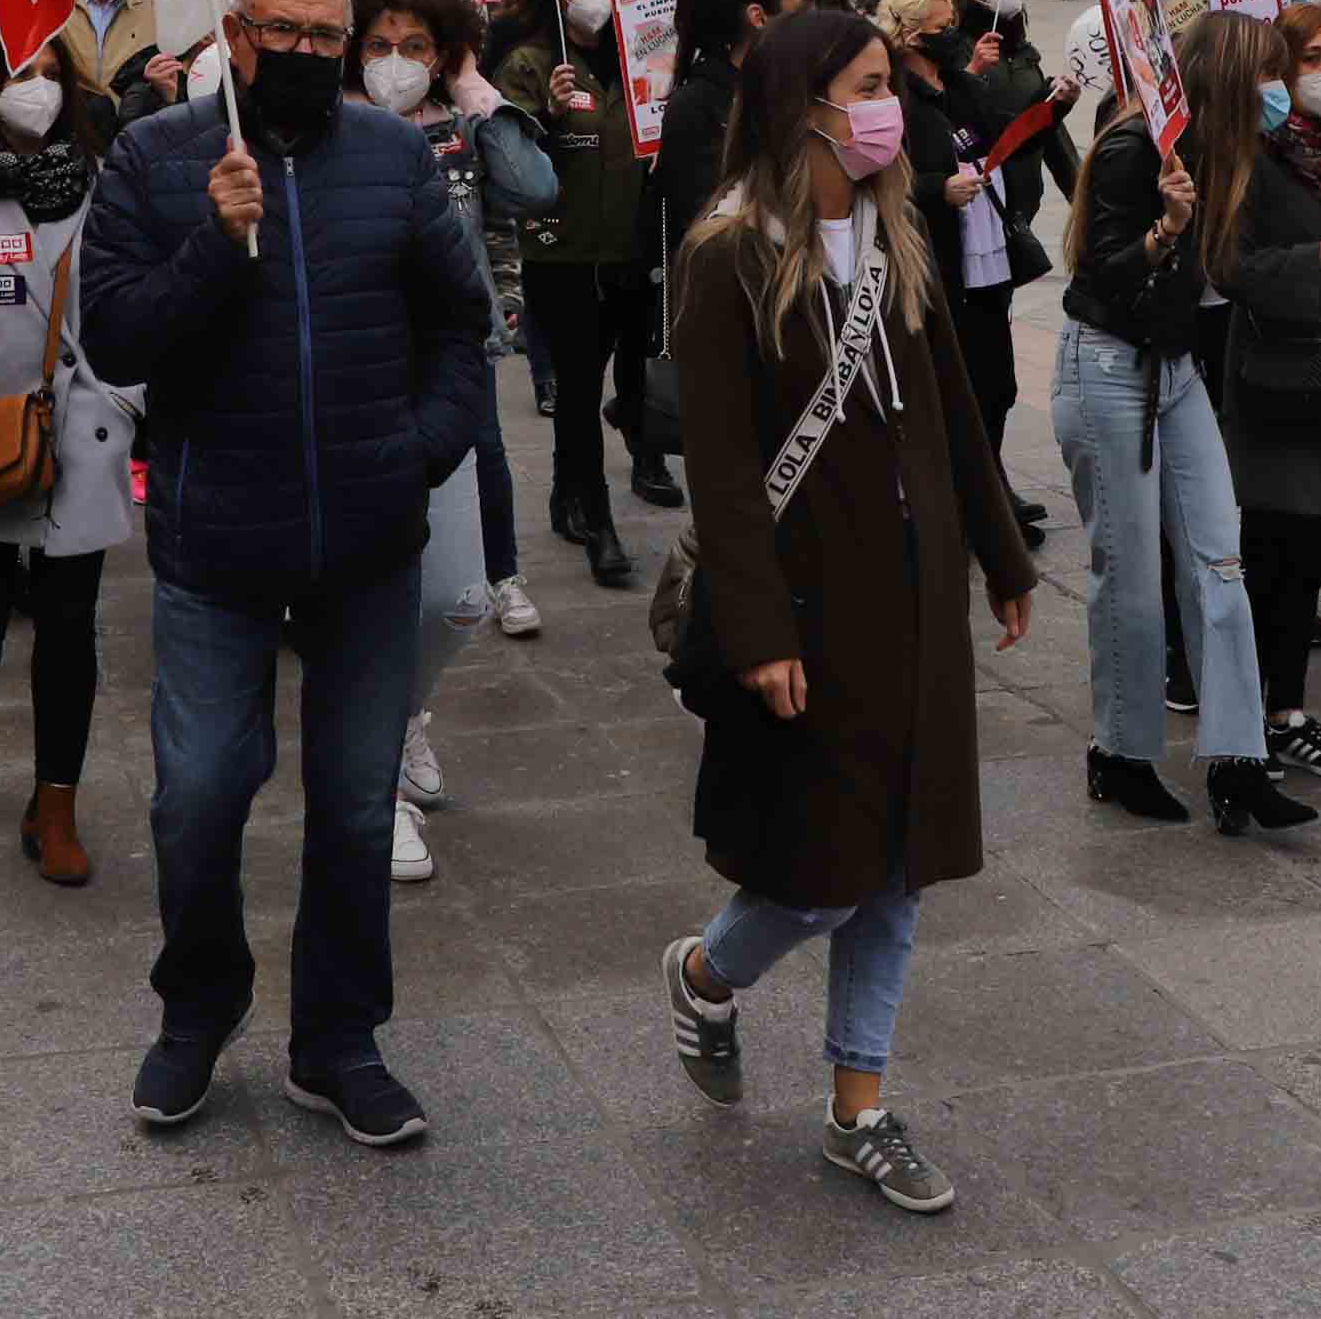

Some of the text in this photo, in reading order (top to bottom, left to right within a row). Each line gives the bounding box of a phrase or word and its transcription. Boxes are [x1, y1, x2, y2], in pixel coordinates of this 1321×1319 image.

[636, 3, 647, 12] EL
[644, 5, 675, 19] PUEDE
[1175, 3, 1204, 25] LUCHA
[635, 45, 649, 62] EN
[852, 265, 883, 326] LOLA
[768, 433, 818, 497] LOLA
